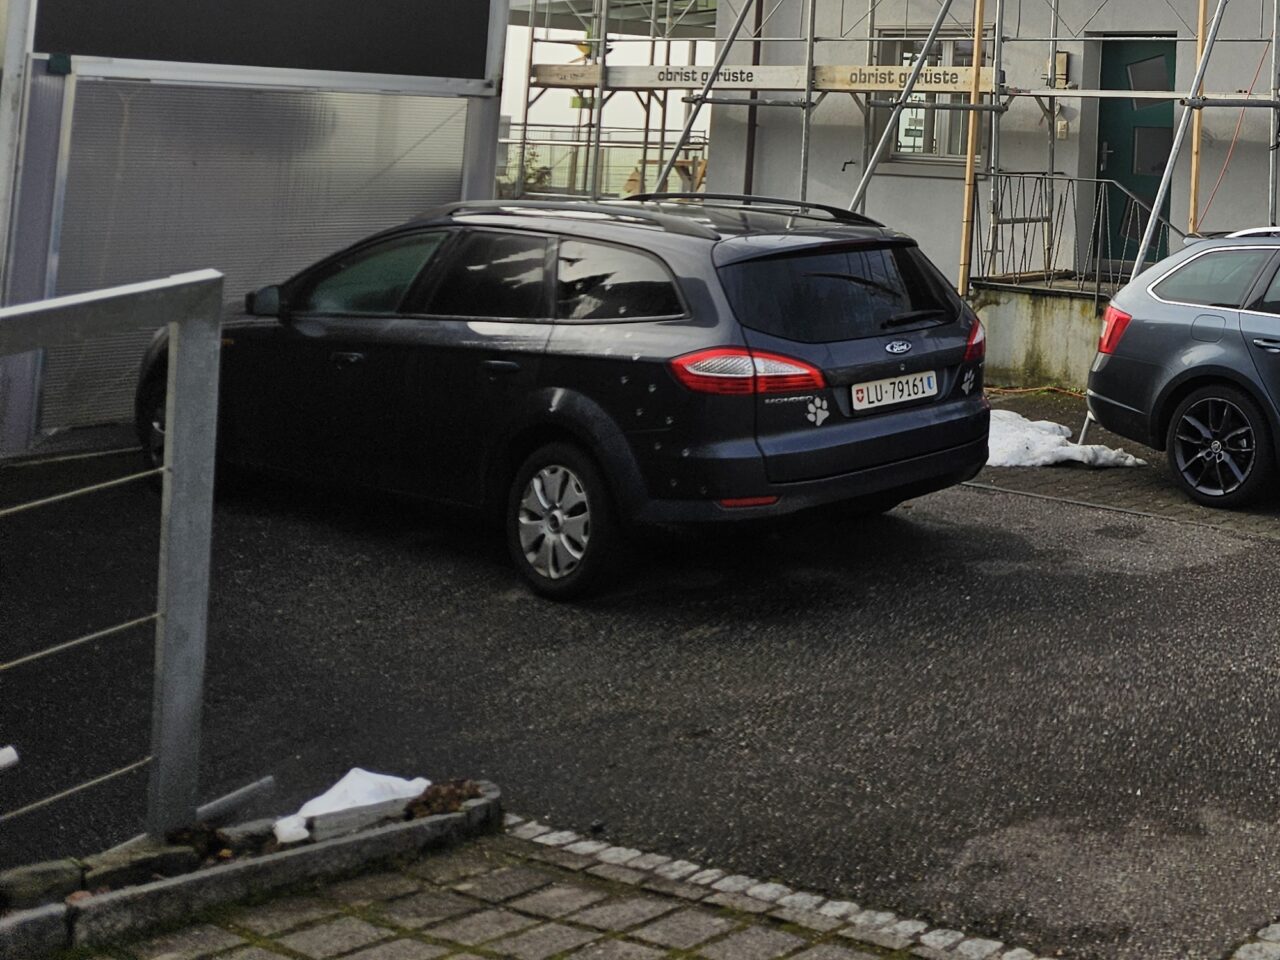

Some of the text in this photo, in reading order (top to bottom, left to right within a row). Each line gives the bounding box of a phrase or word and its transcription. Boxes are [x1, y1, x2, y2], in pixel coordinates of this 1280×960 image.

[657, 69, 754, 85] obrist grüste
[850, 69, 959, 88] obrist grüste
